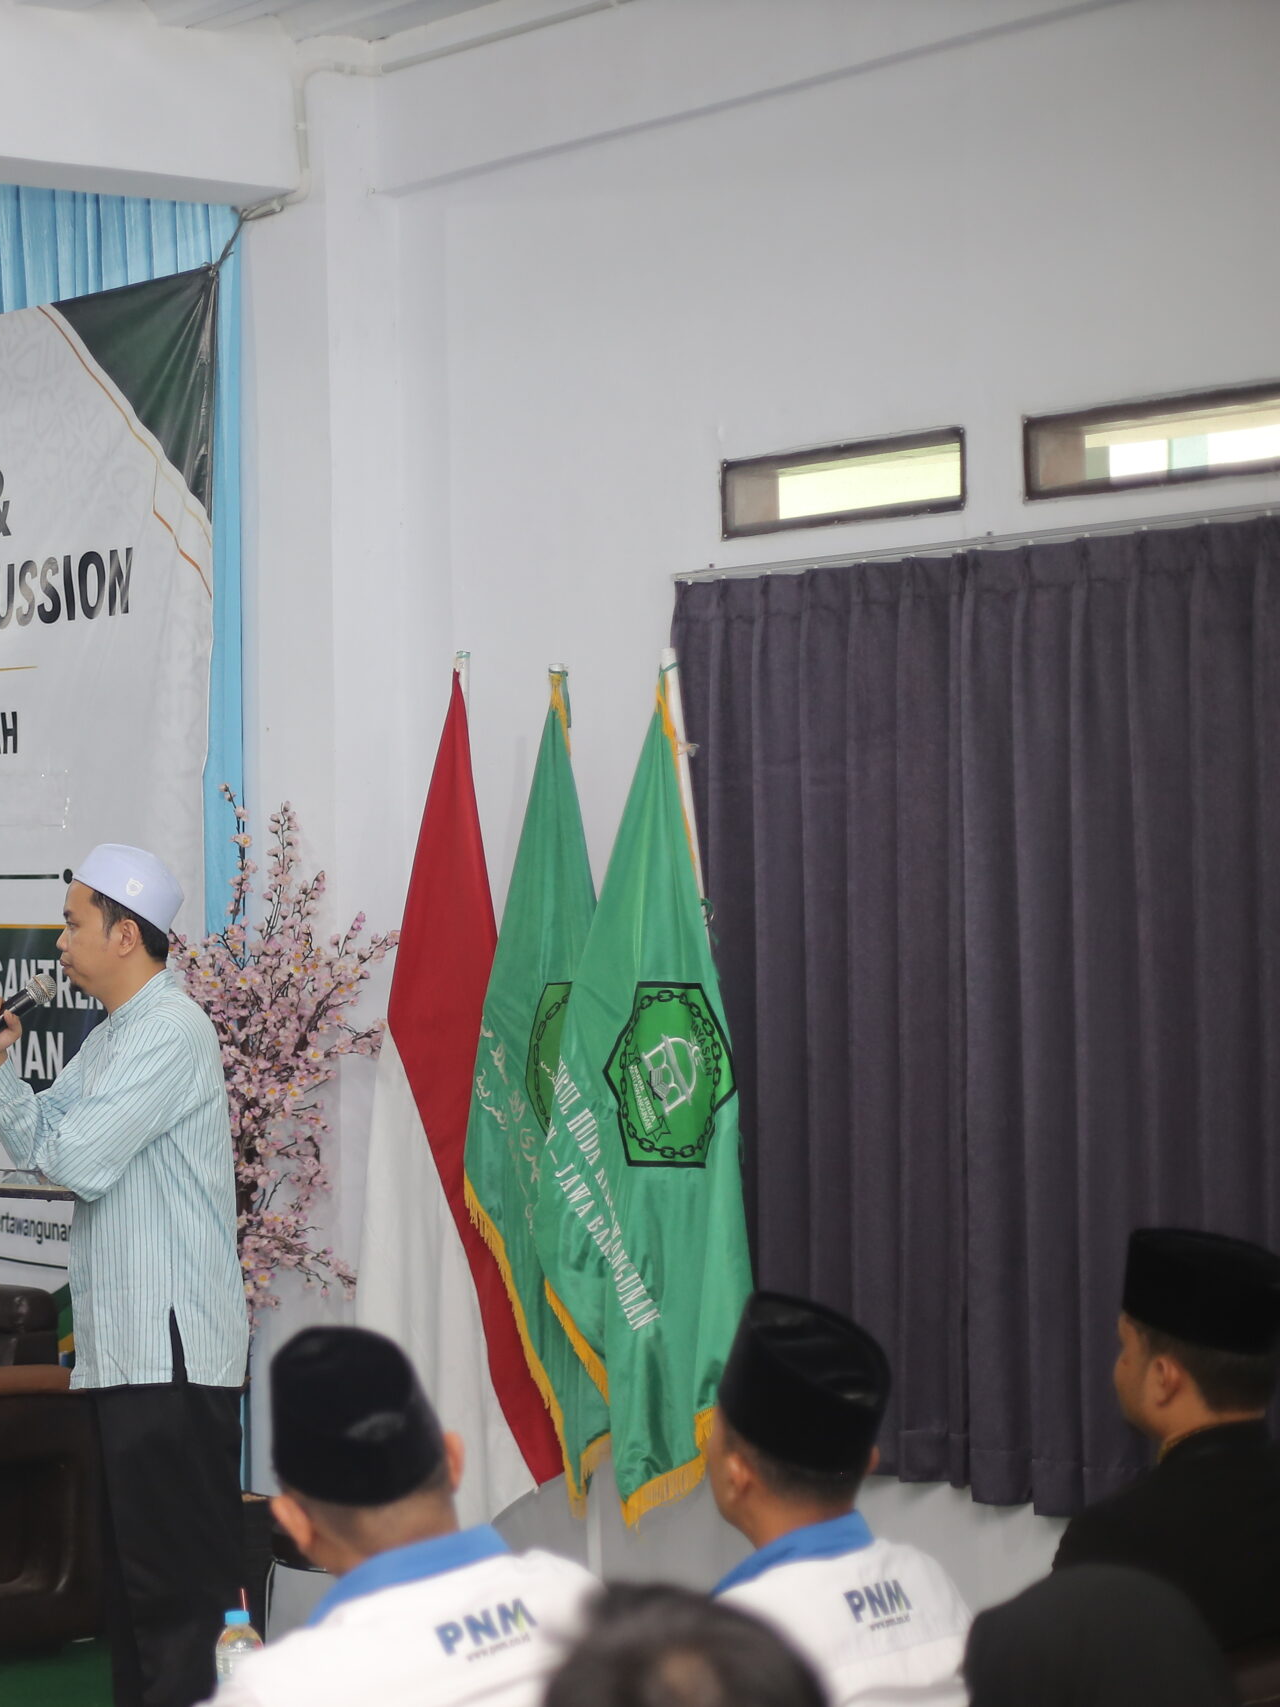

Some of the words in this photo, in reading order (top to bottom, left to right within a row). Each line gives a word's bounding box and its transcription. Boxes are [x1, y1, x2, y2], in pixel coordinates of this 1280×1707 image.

[566, 1108, 601, 1167] HUDA
[555, 1163, 596, 1218] JAWA
[435, 1598, 539, 1656] PNM
[843, 1579, 913, 1624] PNM
